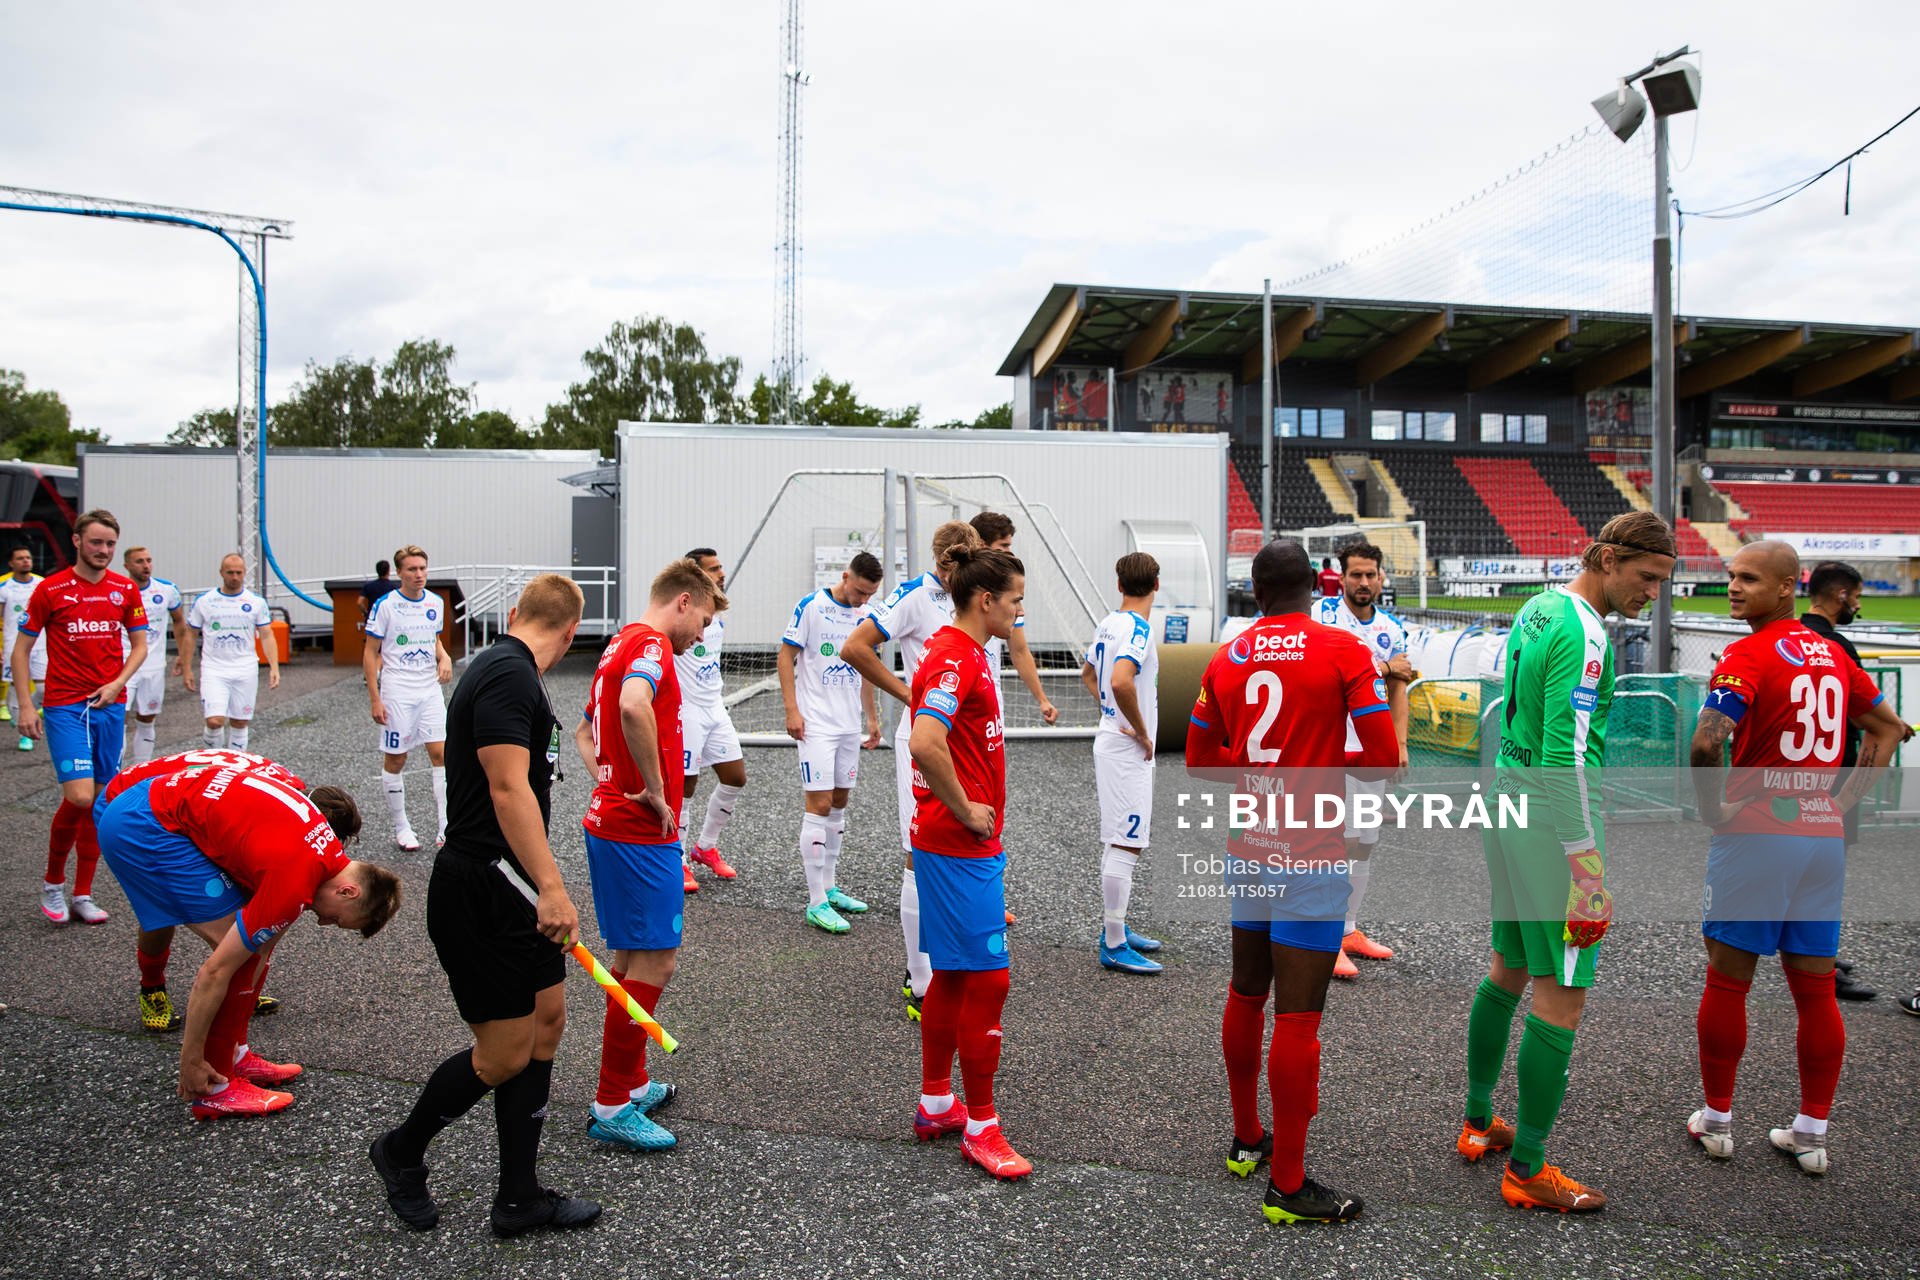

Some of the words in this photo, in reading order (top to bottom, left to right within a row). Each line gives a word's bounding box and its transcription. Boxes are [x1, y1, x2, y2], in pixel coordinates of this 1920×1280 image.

[1728, 404, 1778, 416] BAUHAUS
[1803, 537, 1865, 550] Akropolis
[1444, 582, 1502, 598] UNIBET
[67, 618, 110, 633] akea
[1254, 631, 1308, 651] beat
[1253, 650, 1305, 663] diabetes
[1505, 643, 1523, 731] 1
[1573, 690, 1597, 703] UNIBET
[1245, 669, 1283, 763] 2
[1779, 674, 1844, 763] 39
[384, 730, 400, 749] 16
[800, 761, 811, 784] 11
[1763, 769, 1792, 790] VAN
[1794, 771, 1820, 791] DEN
[1800, 797, 1833, 812] Solid
[1126, 814, 1141, 839] 2
[1243, 833, 1291, 854] Försäkring
